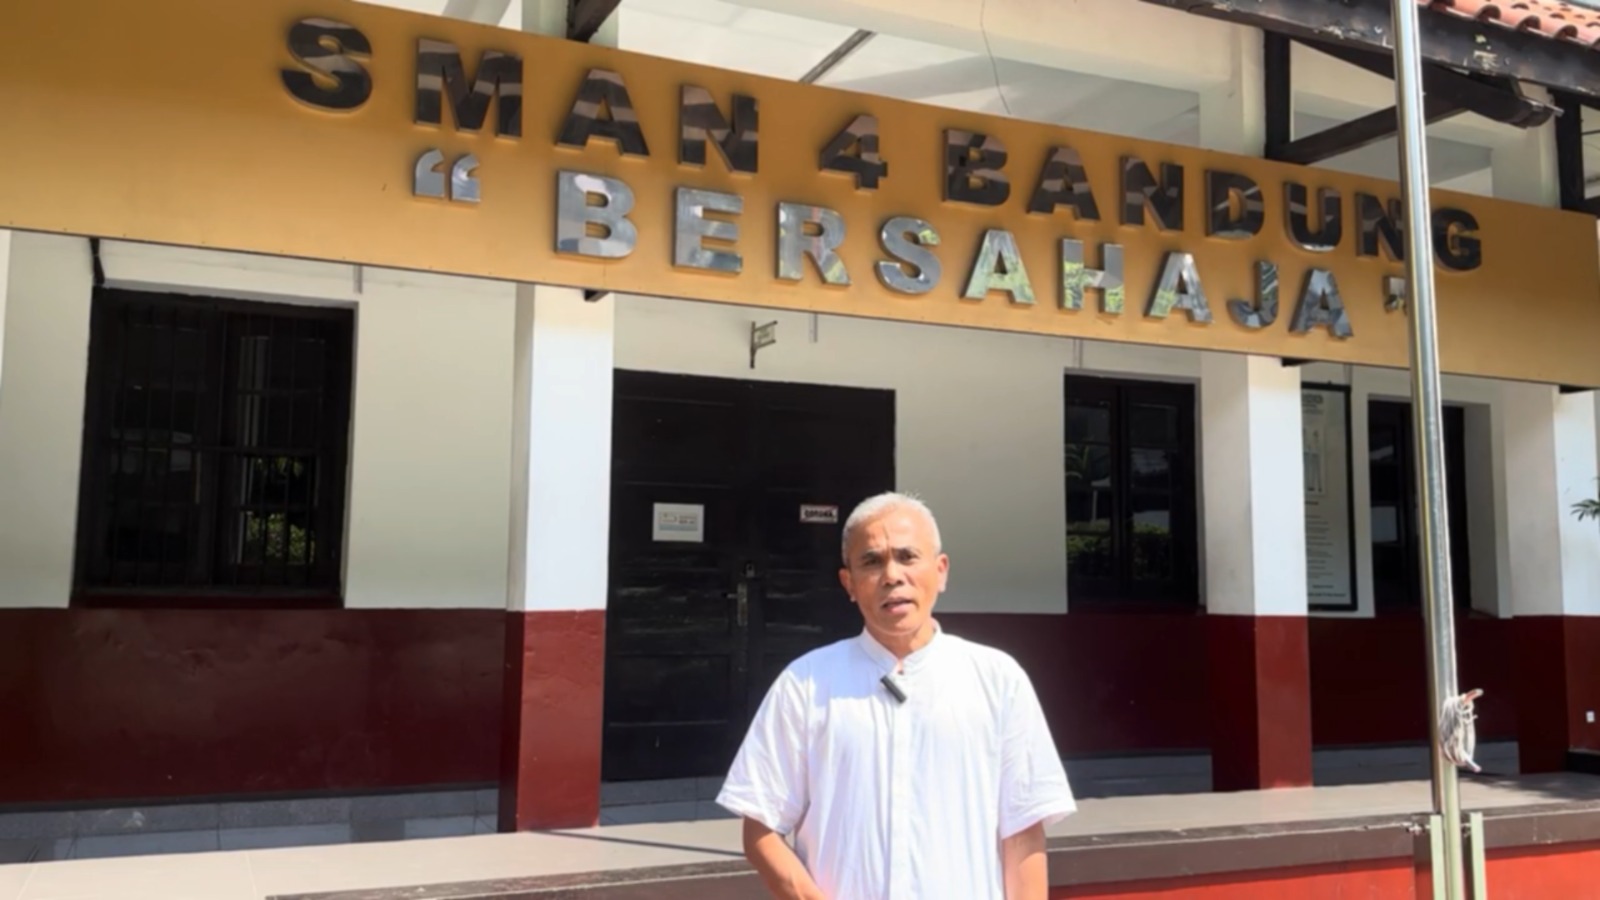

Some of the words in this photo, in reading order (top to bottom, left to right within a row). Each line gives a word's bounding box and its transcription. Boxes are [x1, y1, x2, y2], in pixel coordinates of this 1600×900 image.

[281, 17, 760, 174] SMAN
[819, 113, 889, 191] 4
[942, 128, 1483, 272] BANDUNG
